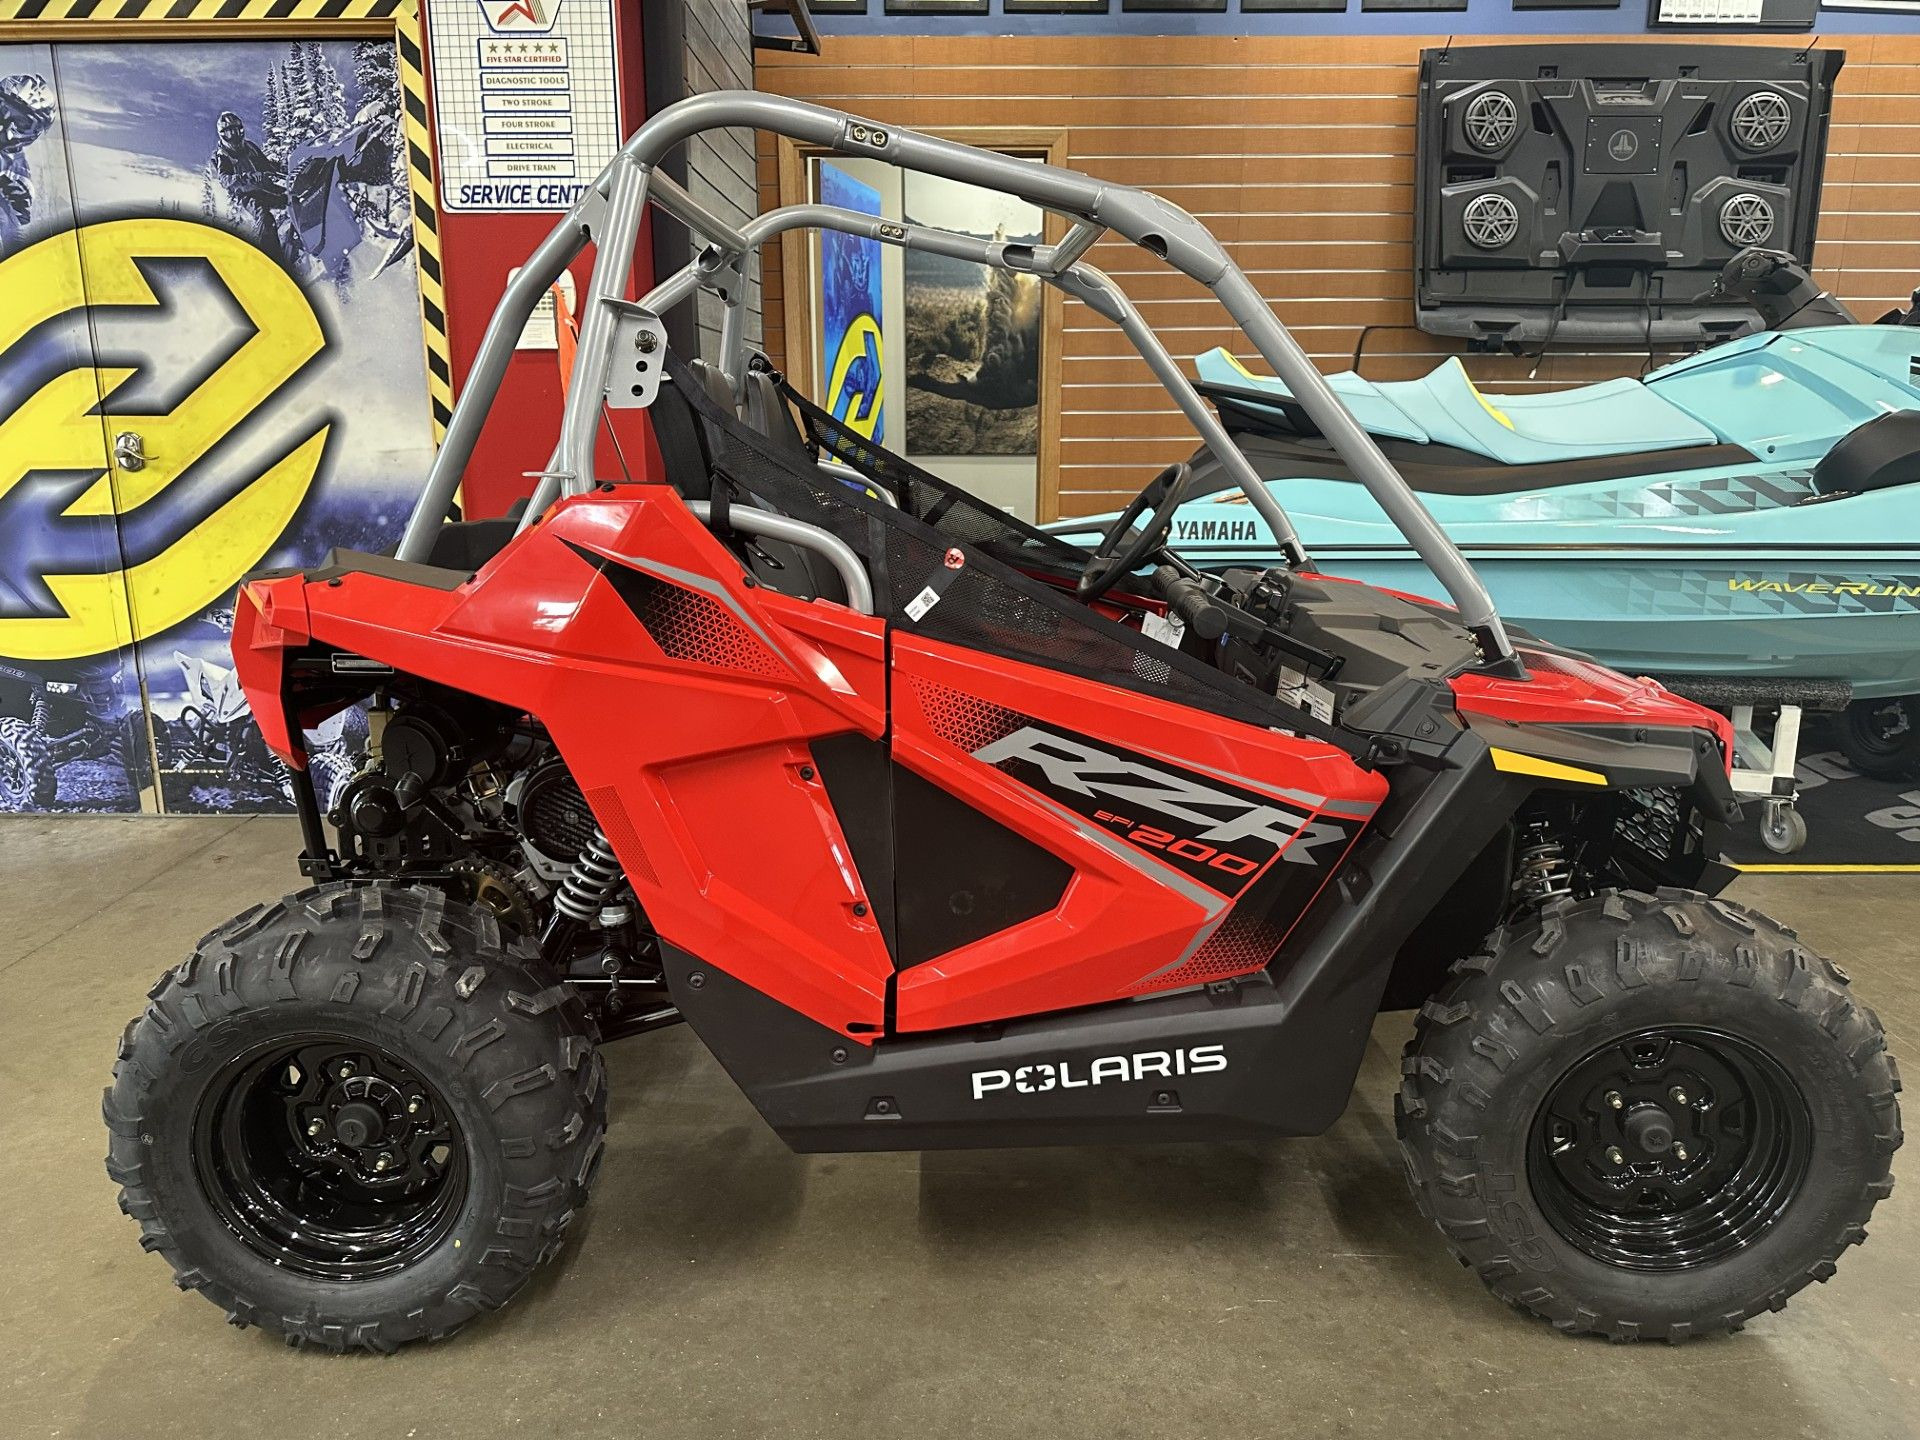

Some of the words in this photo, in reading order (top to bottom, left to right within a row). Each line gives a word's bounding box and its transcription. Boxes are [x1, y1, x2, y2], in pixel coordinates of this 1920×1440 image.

[523, 55, 562, 63] CERTIFIED
[486, 77, 537, 85] DIAGNOSTIC
[539, 77, 565, 85] TOOLS
[507, 164, 531, 172] DRIVE
[532, 164, 556, 172] TRAIN
[460, 184, 532, 204] SERVICE
[1177, 520, 1257, 541] YAMAHA
[970, 726, 1347, 866] RZR
[1093, 810, 1136, 830] EFI
[1127, 826, 1259, 876] 200
[971, 1044, 1228, 1100] POLARIS
